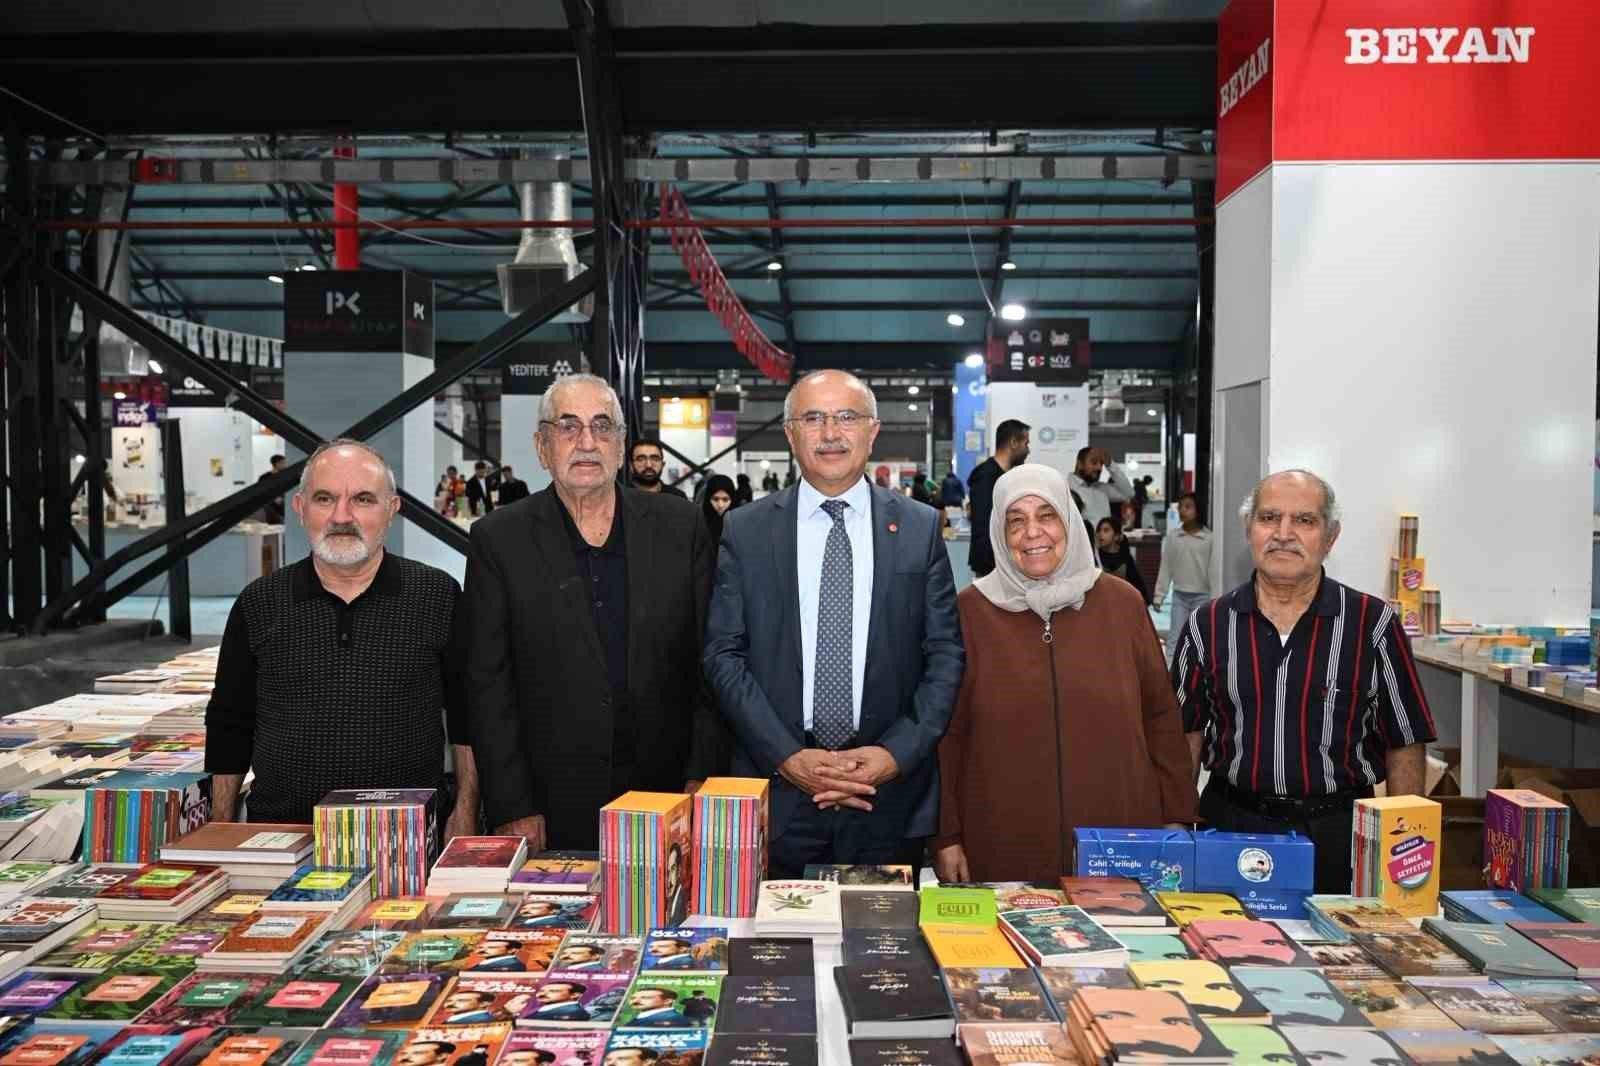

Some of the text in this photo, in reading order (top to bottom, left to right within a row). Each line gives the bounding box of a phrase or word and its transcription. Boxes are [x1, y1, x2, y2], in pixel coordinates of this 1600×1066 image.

[1344, 27, 1536, 65] BEYAN
[1219, 38, 1270, 118] BEYAN
[1088, 859, 1107, 868] Cahit
[1402, 853, 1423, 866] ÖMER
